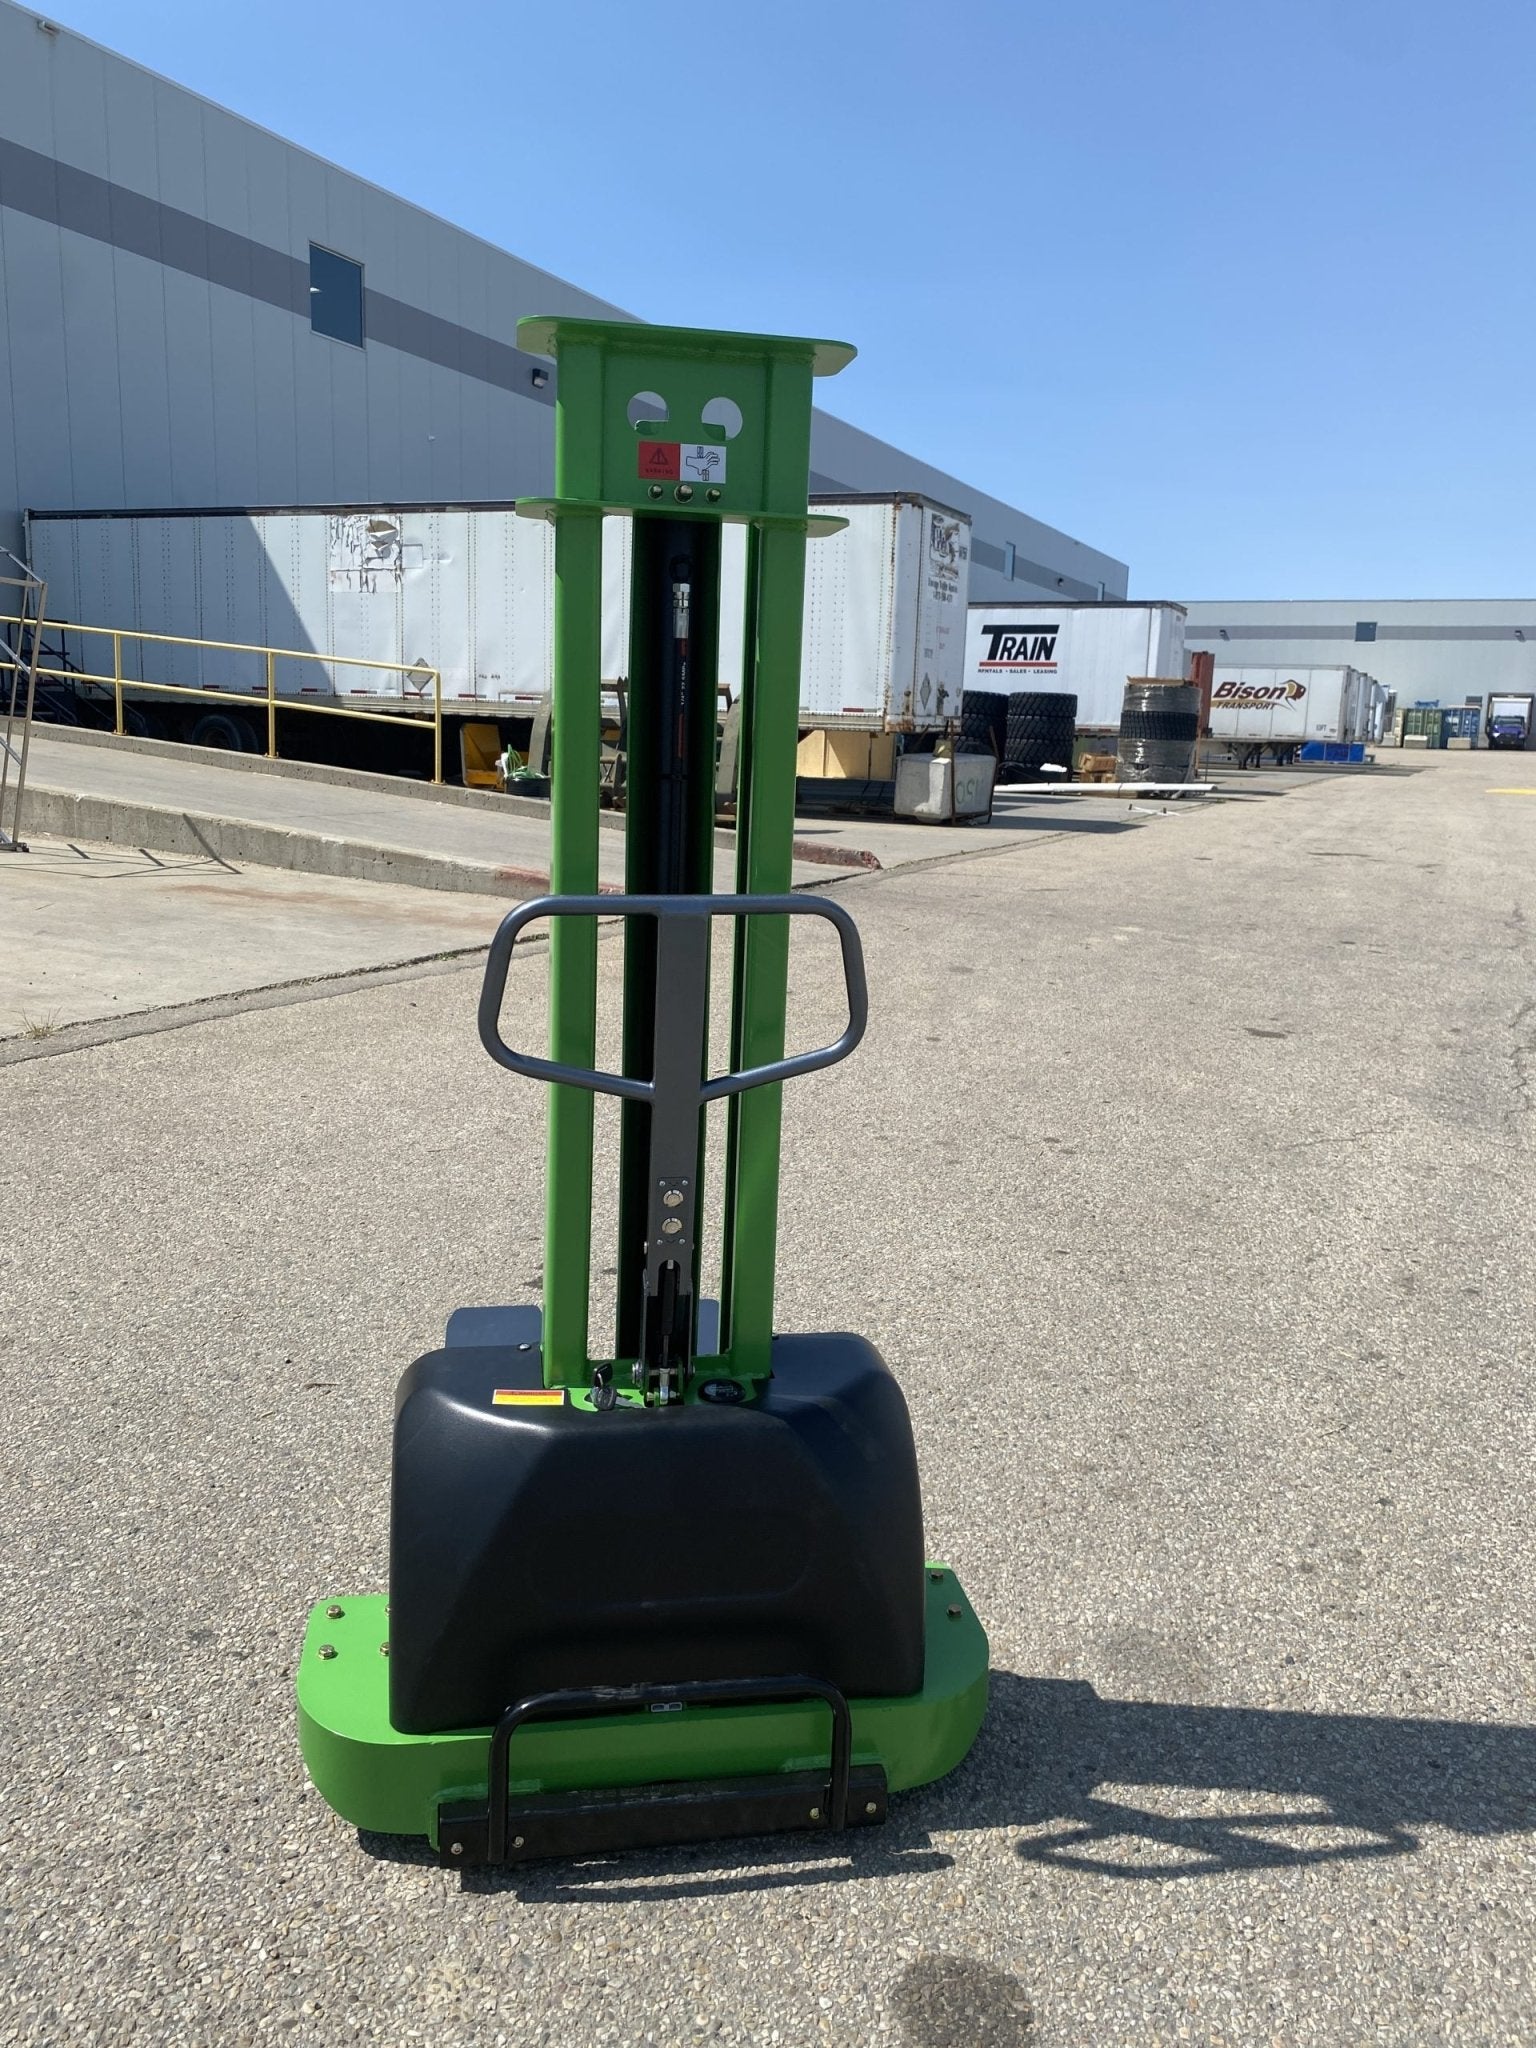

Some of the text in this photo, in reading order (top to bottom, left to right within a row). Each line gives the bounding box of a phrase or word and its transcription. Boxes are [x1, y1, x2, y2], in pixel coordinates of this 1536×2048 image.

[981, 624, 1061, 661] TRAIN
[1033, 669, 1058, 677] LEASING
[1212, 681, 1289, 700] Bison
[1216, 700, 1278, 710] TRANSPORT
